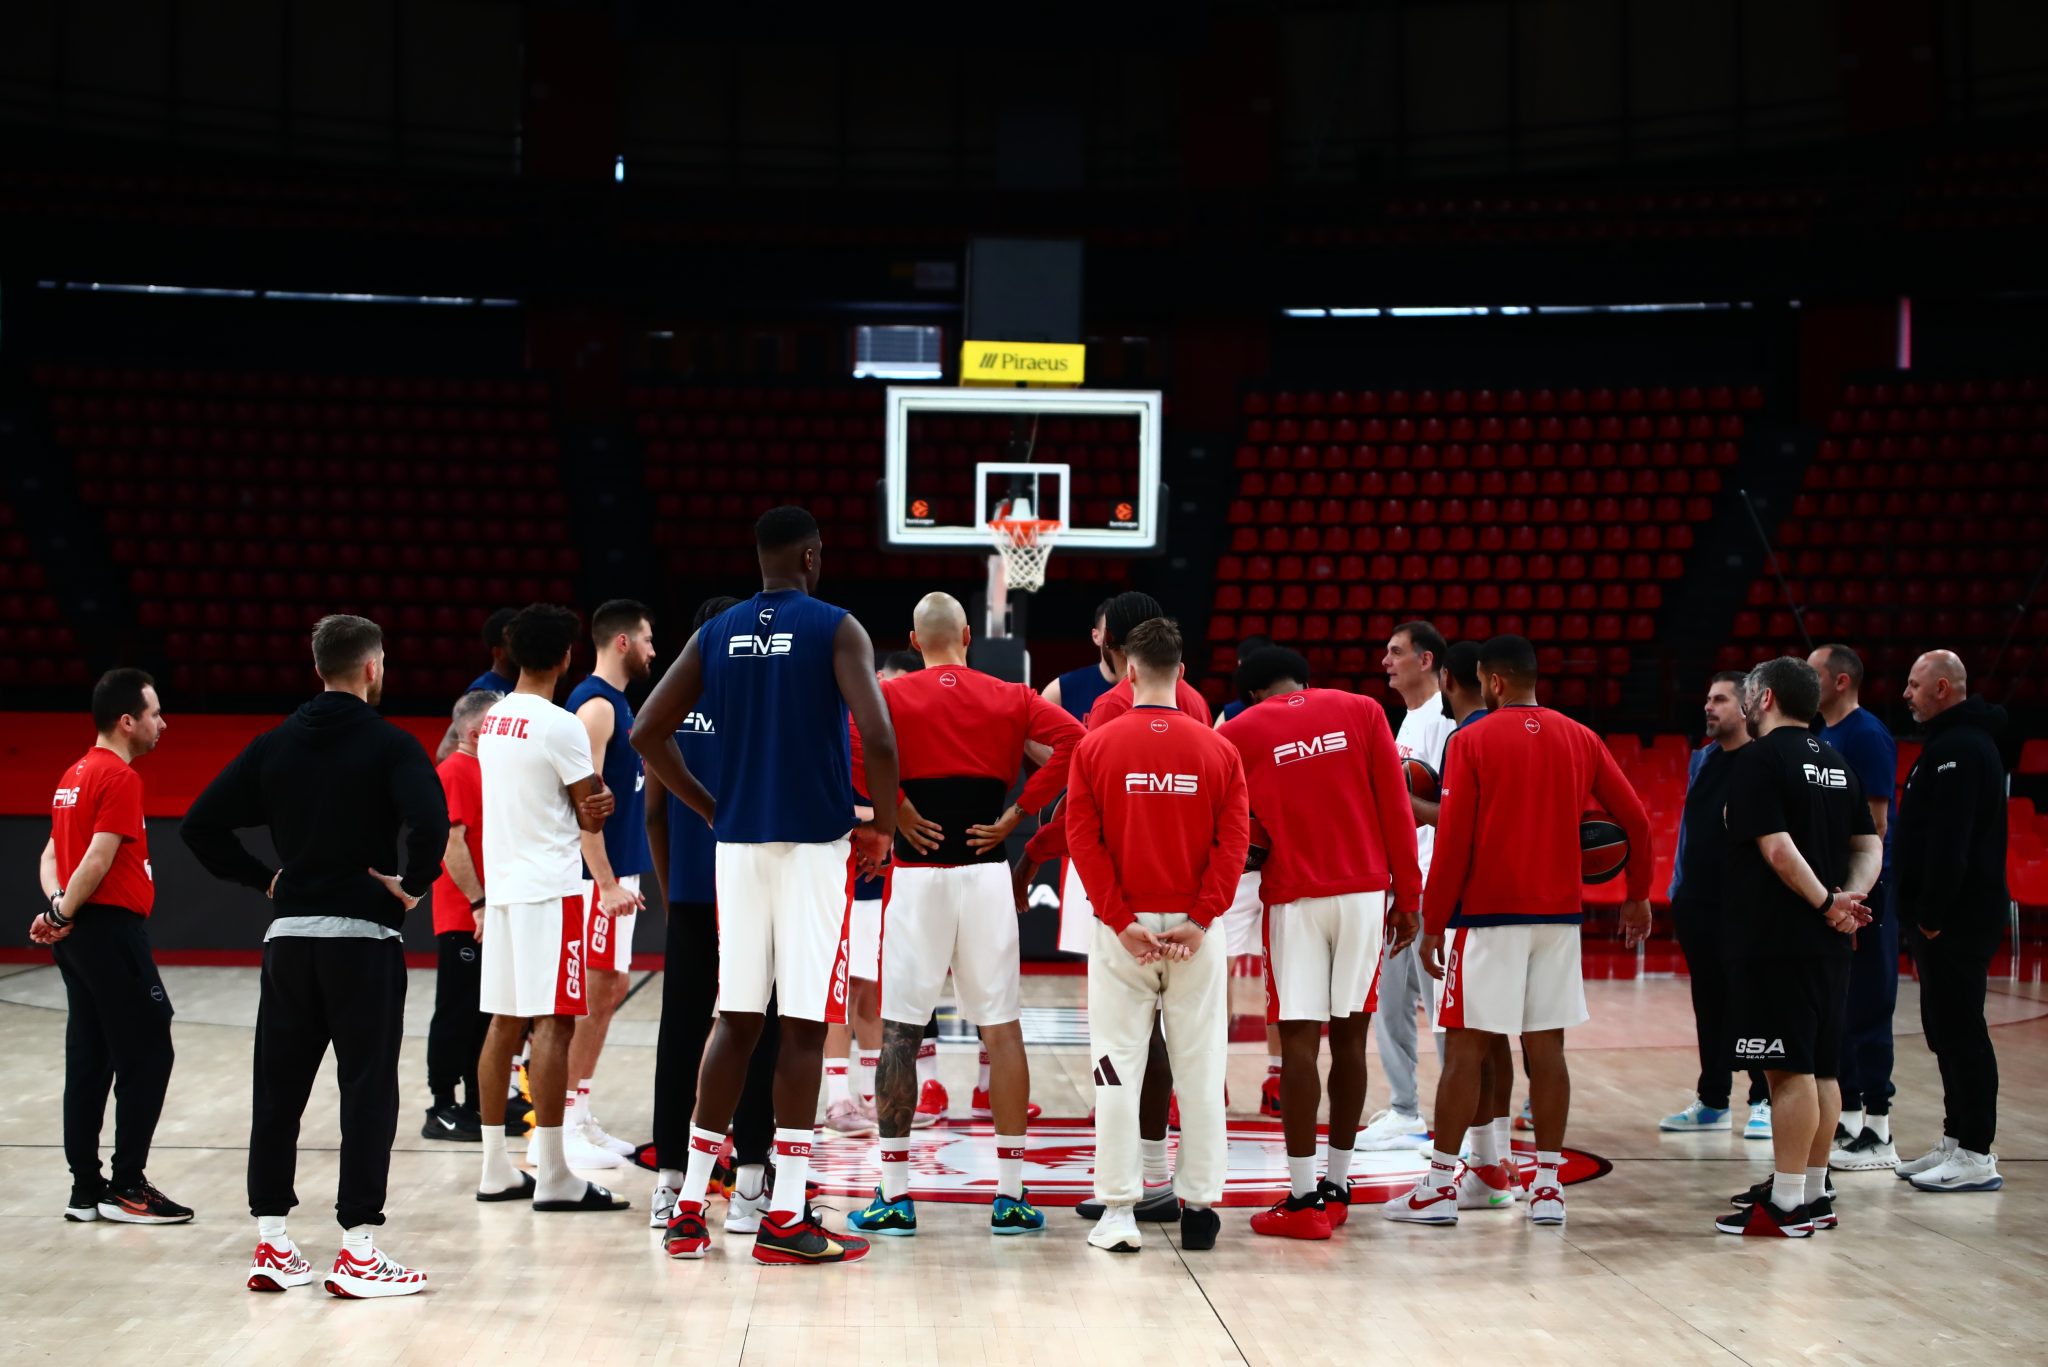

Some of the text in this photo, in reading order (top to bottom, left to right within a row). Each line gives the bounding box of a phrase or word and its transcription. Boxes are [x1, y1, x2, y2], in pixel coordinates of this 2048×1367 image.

[1002, 353, 1068, 371] Piraeus
[729, 633, 793, 655] FMS
[512, 717, 529, 739] IT.
[1273, 731, 1347, 764] FMS
[1125, 773, 1198, 793] FMS
[1803, 764, 1847, 786] FMS
[566, 940, 580, 1000] GSA
[834, 939, 848, 1004] GSA
[1446, 949, 1458, 1008] GSA
[1735, 1038, 1785, 1053] GSA
